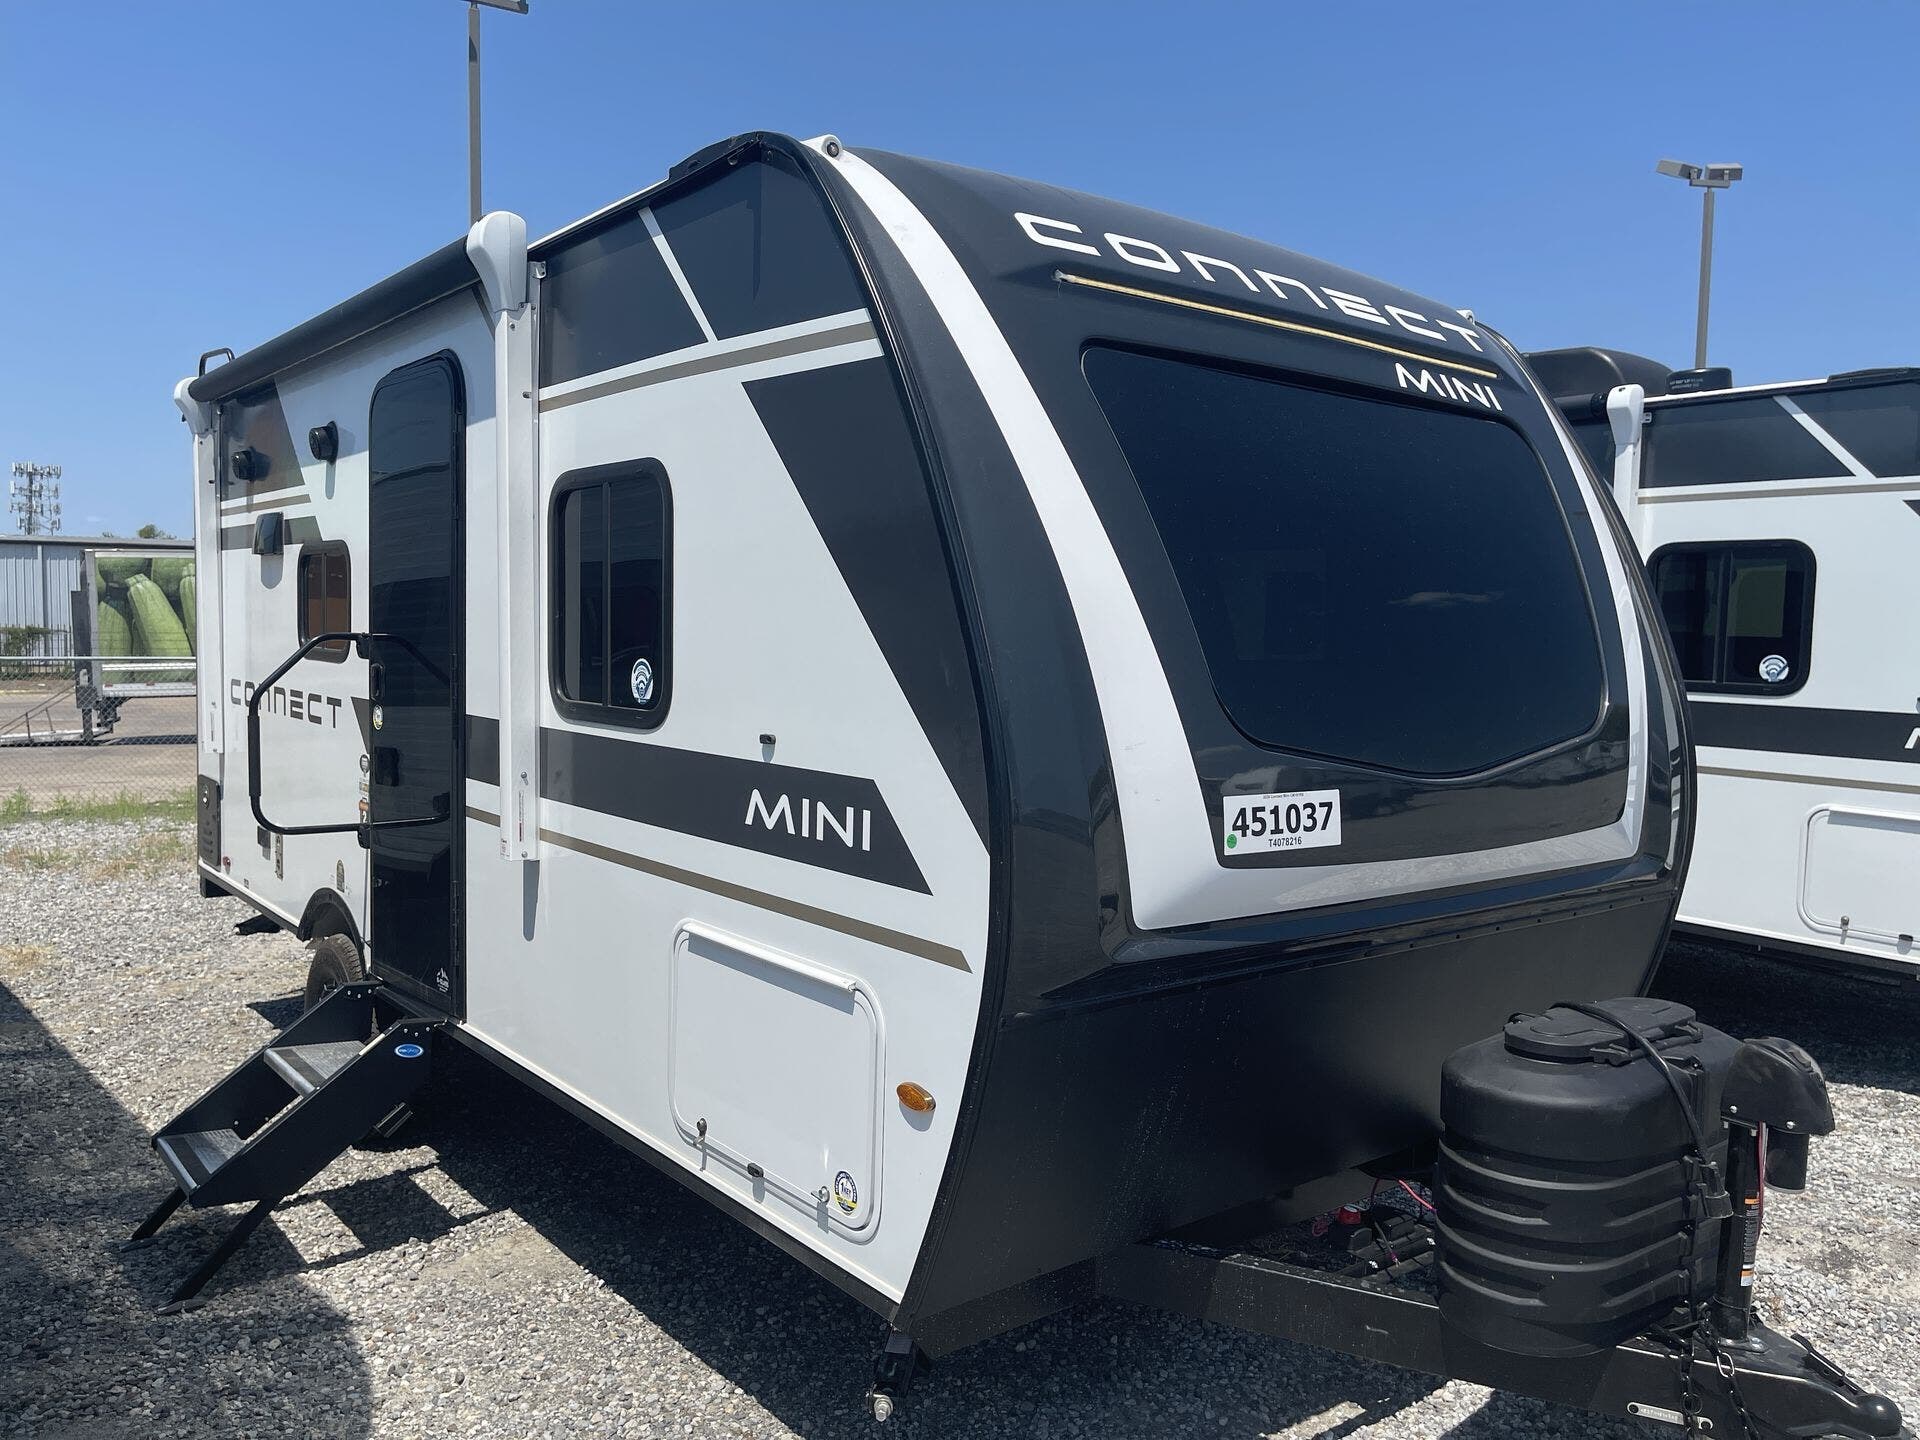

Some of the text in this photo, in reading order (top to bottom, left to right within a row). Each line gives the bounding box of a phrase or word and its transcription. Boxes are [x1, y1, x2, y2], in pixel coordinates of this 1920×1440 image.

[1395, 362, 1503, 411] MINI
[745, 788, 871, 852] MINI
[1232, 801, 1333, 837] 451037
[1268, 836, 1303, 848] T4078216
